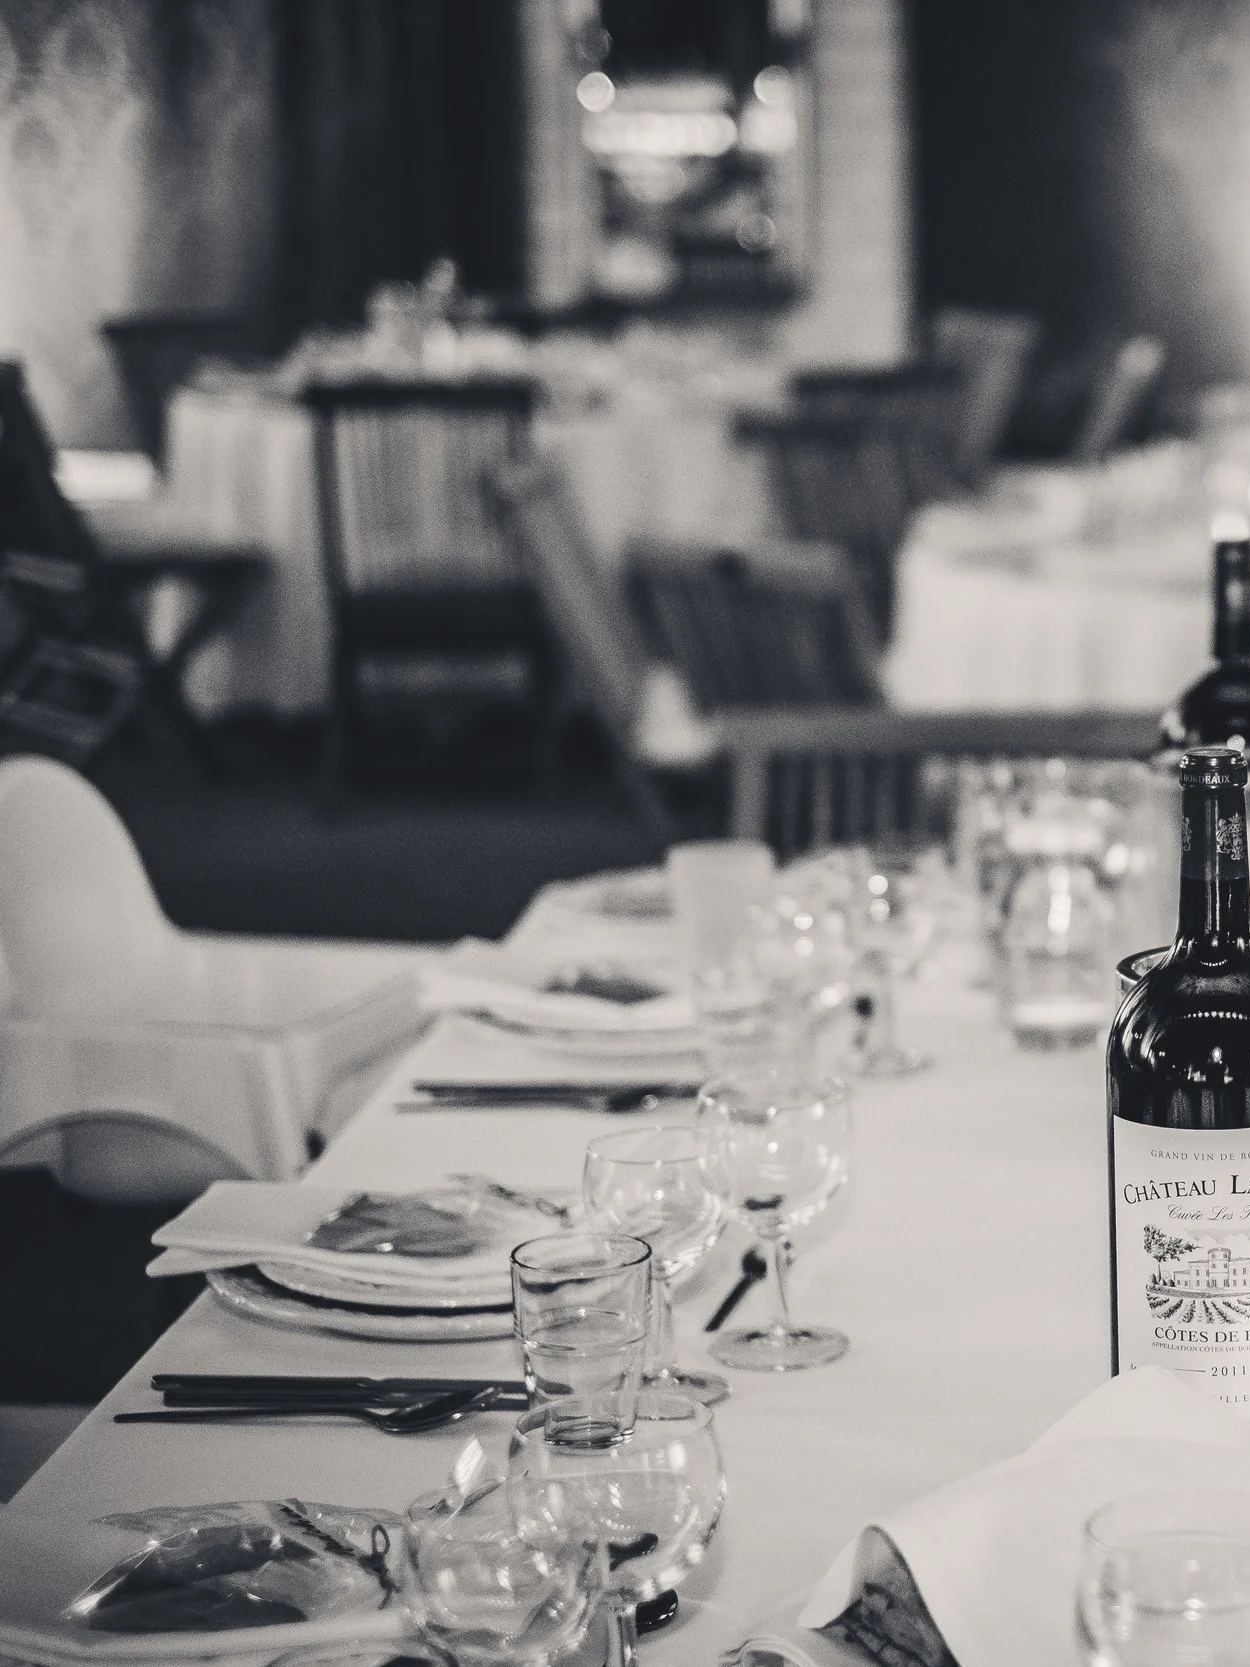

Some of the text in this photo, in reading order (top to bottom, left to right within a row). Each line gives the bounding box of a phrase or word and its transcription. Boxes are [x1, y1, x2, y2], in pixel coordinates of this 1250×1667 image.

[1183, 774, 1231, 784] BORDEAUX
[1151, 1149, 1188, 1161] GRAND
[1194, 1153, 1215, 1161] VIN
[1220, 1153, 1235, 1161] DE
[1123, 1179, 1217, 1205] CHÂTEAU
[1207, 1205, 1234, 1220] Les
[1154, 1325, 1209, 1343] CÔTES
[1215, 1330, 1240, 1343] DE
[1151, 1341, 1198, 1352] APPELLATION
[1211, 1365, 1247, 1377] 2011
